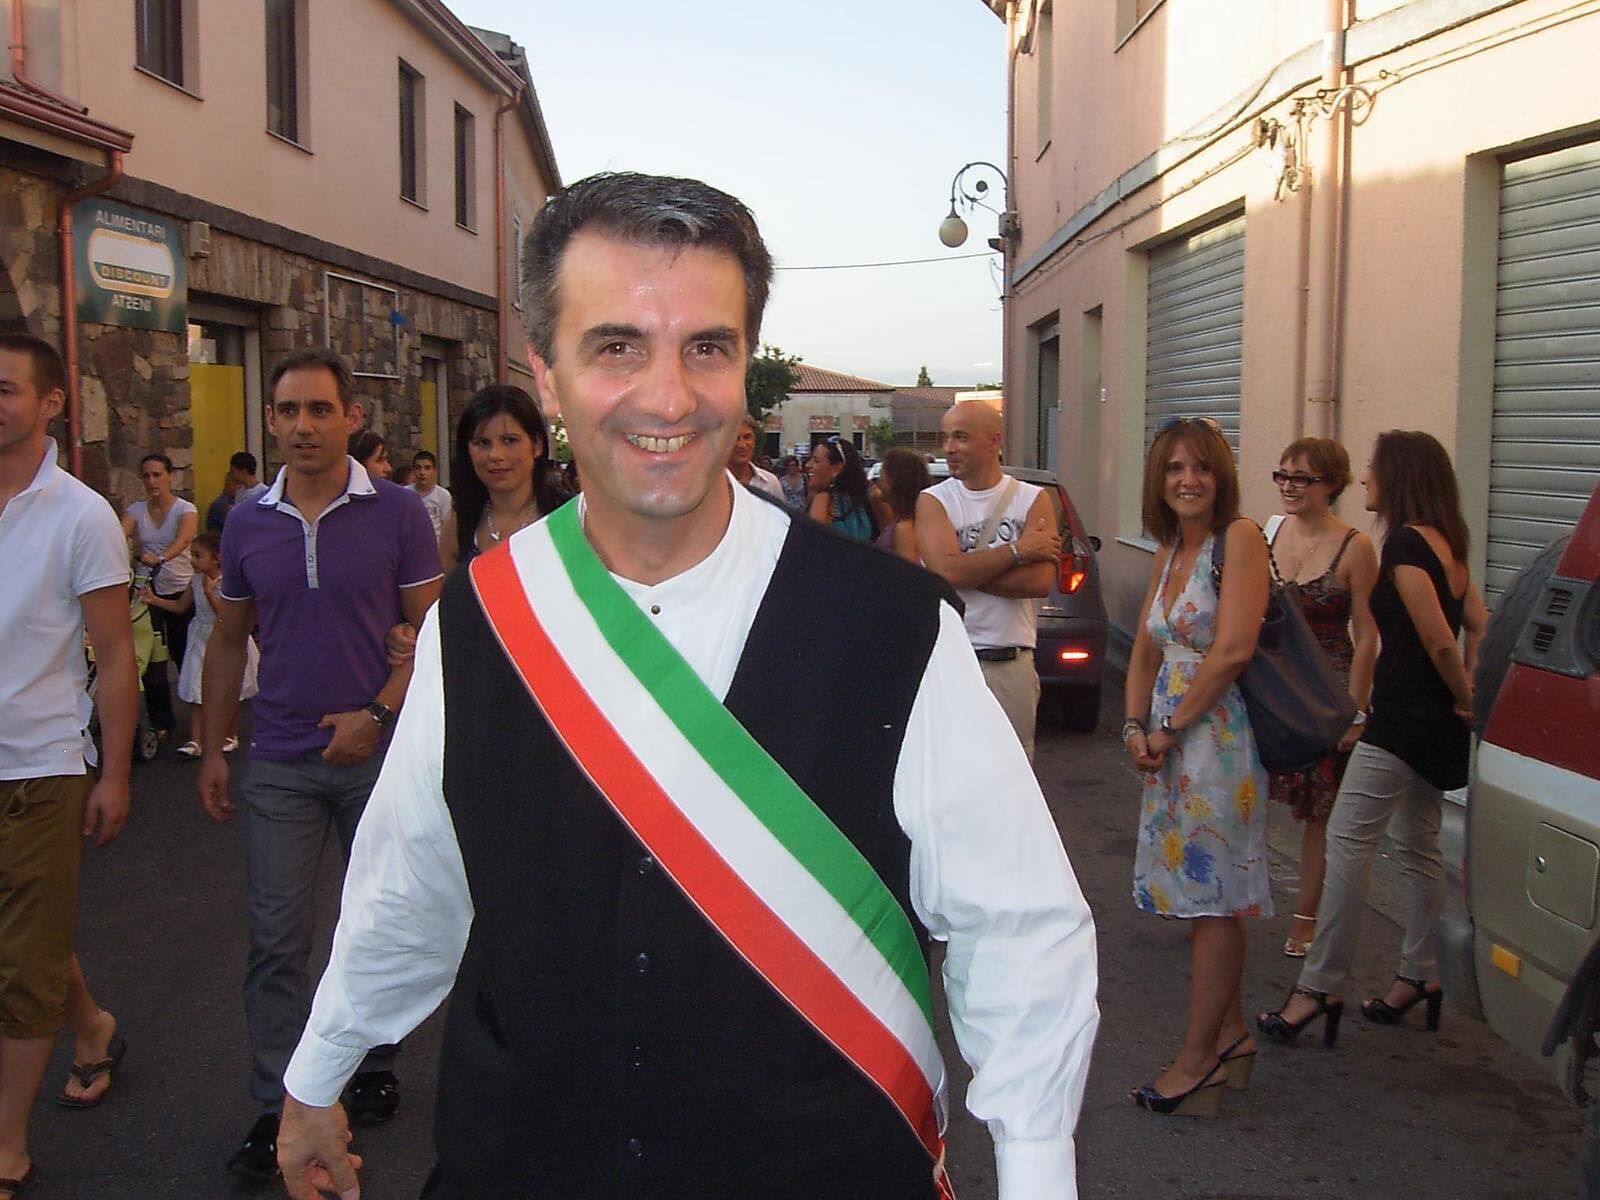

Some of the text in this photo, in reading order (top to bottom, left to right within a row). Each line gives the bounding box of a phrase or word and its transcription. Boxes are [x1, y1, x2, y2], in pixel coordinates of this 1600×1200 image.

[96, 210, 166, 239] ALIMENTARI
[101, 265, 167, 287] DISCOUNT
[112, 294, 151, 312] ATZENI
